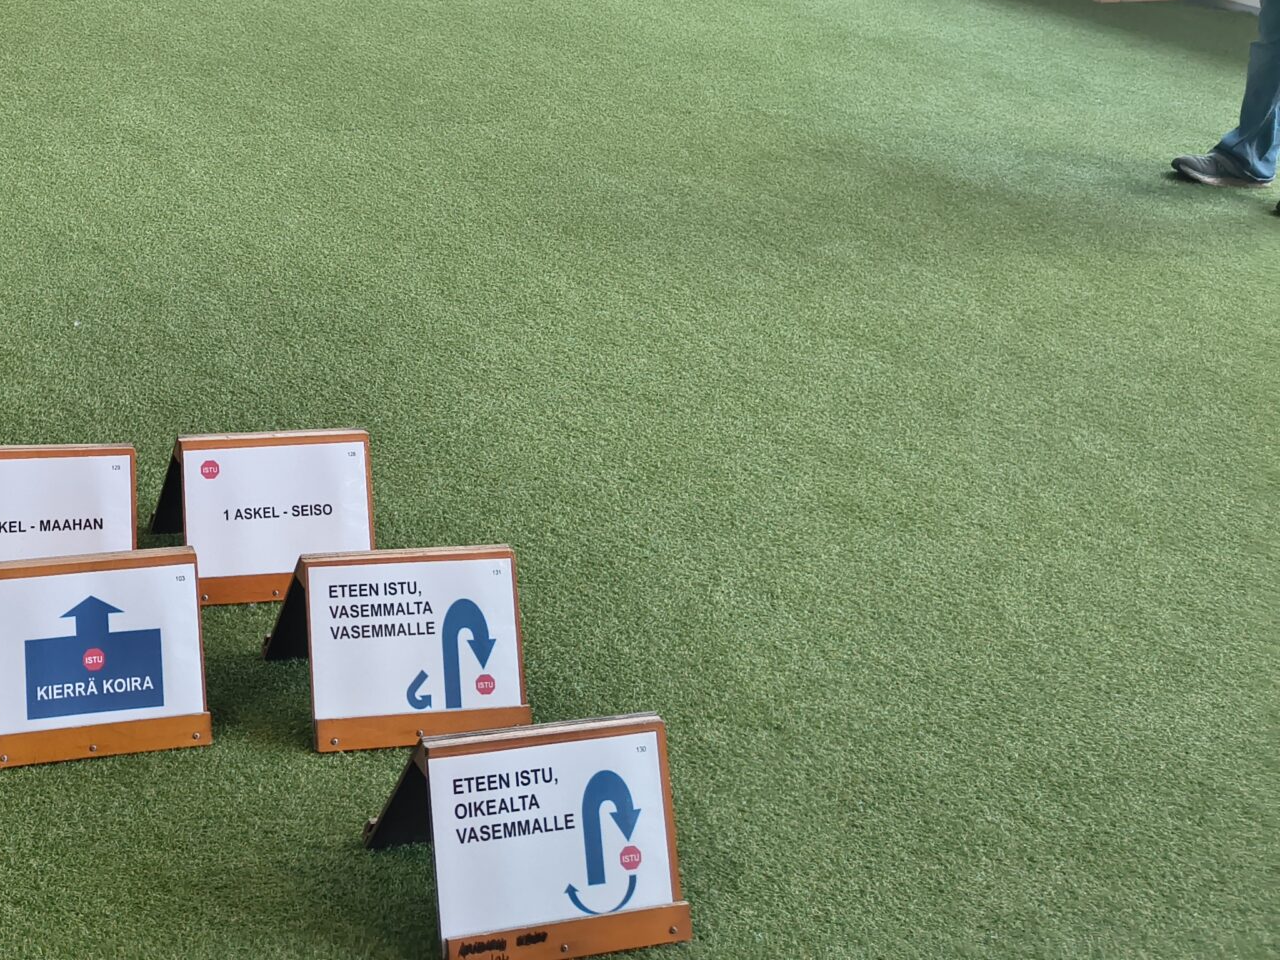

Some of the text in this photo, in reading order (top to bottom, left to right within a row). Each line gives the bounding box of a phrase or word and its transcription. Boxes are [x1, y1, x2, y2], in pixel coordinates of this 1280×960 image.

[202, 465, 218, 474] ISTU
[223, 509, 229, 521] 1
[234, 506, 280, 521] ASKEL
[291, 503, 333, 517] SEISO
[39, 517, 104, 532] MAAHAN
[328, 581, 422, 599] ETEEN ISTU,
[329, 601, 434, 620] VASEMMALTA
[330, 621, 436, 640] VASEMMALLE
[85, 656, 103, 665] ISTU
[36, 675, 154, 701] KIERRÄ KOIRA
[477, 680, 494, 689] ISTU
[453, 766, 558, 795] ETEEN ISTU,
[454, 793, 540, 820] OIKEALTA
[455, 813, 576, 845] VASEMMALLE
[622, 853, 640, 864] ISTU
